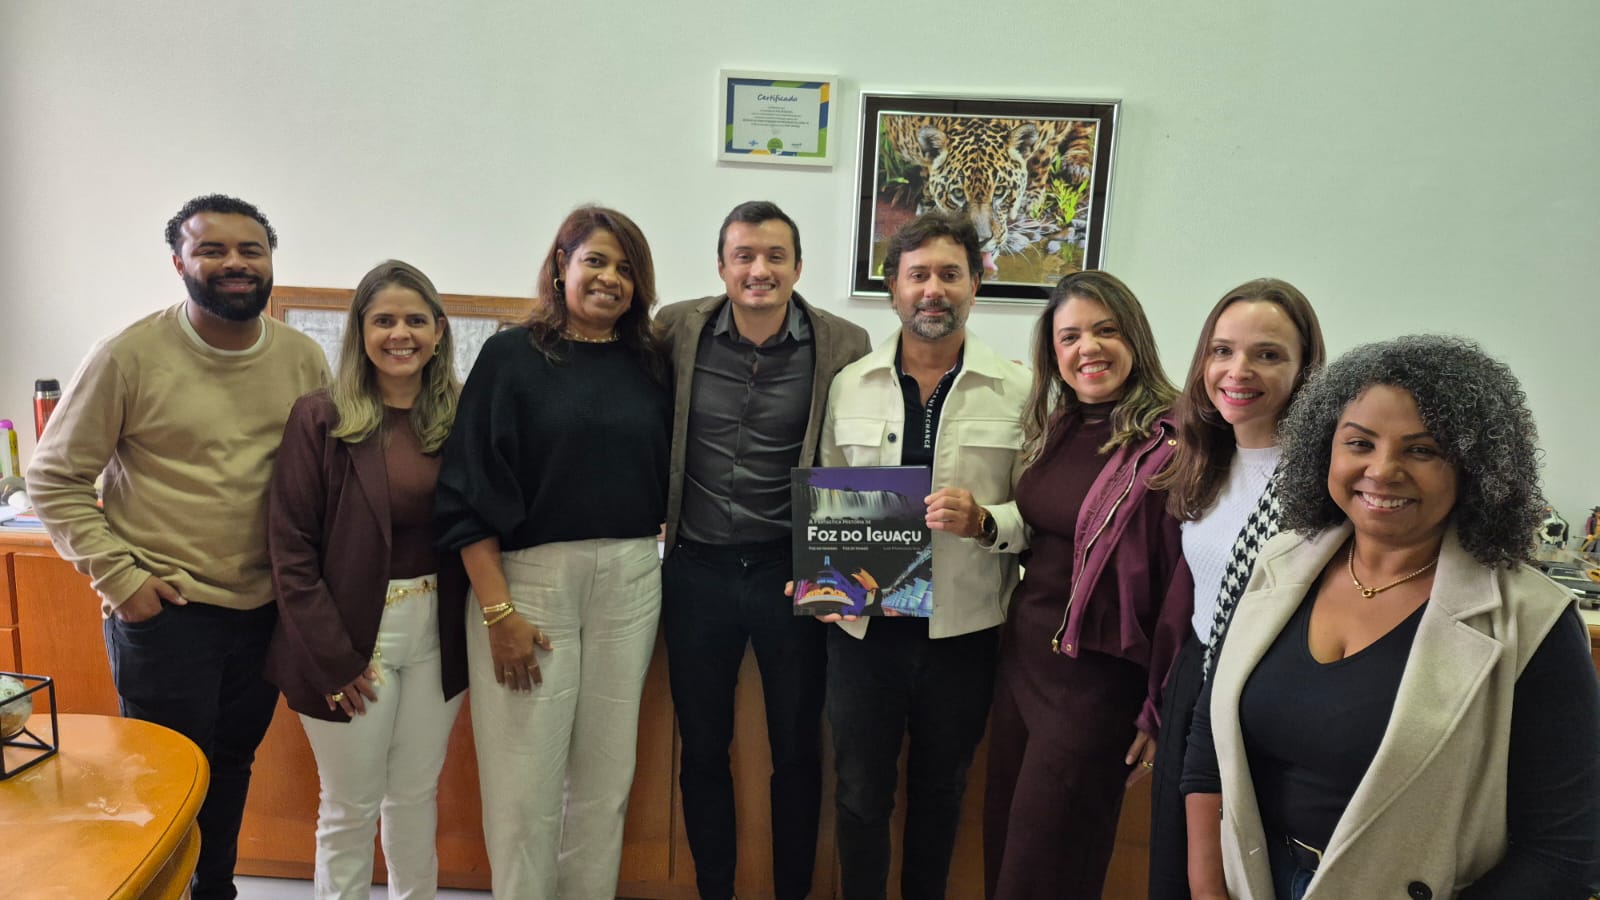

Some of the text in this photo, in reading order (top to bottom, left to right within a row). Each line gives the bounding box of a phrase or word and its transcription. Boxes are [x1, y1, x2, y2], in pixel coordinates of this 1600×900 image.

[923, 409, 933, 449] EXCHANGE
[807, 526, 922, 545] FOZ DO IGUAÇU
